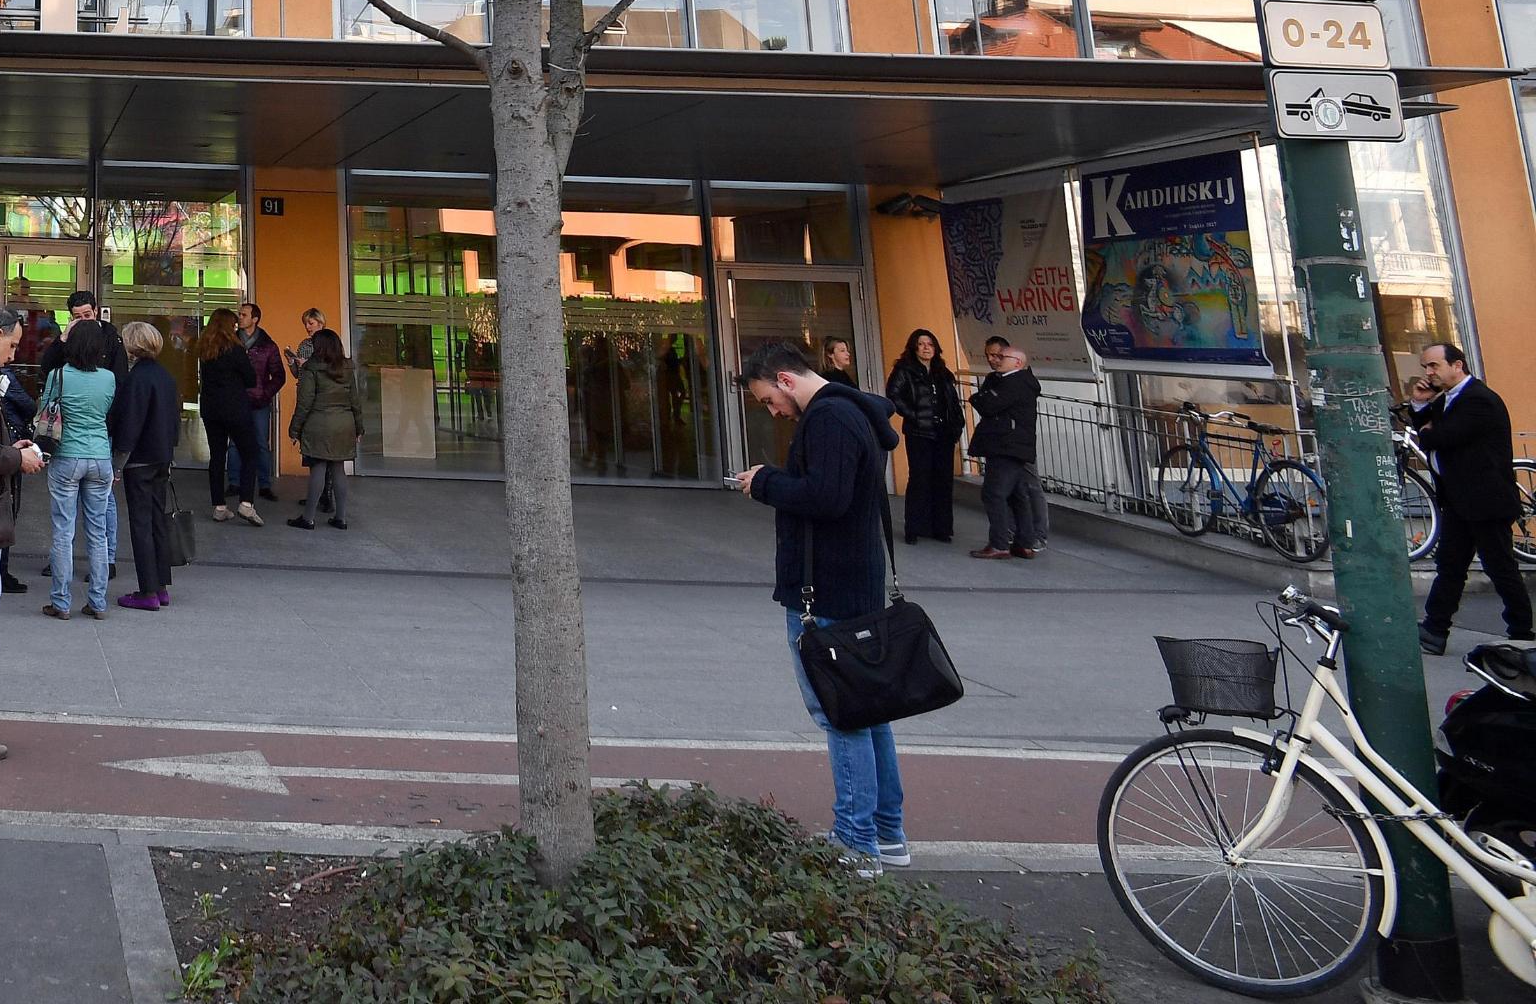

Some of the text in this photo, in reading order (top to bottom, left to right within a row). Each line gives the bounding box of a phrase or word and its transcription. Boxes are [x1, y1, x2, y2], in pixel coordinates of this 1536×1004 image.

[1281, 18, 1372, 50] 0-24
[265, 199, 279, 214] 91
[1089, 172, 1235, 238] KANDINSKIJ
[996, 286, 1074, 313] HARING
[1032, 314, 1048, 326] ART
